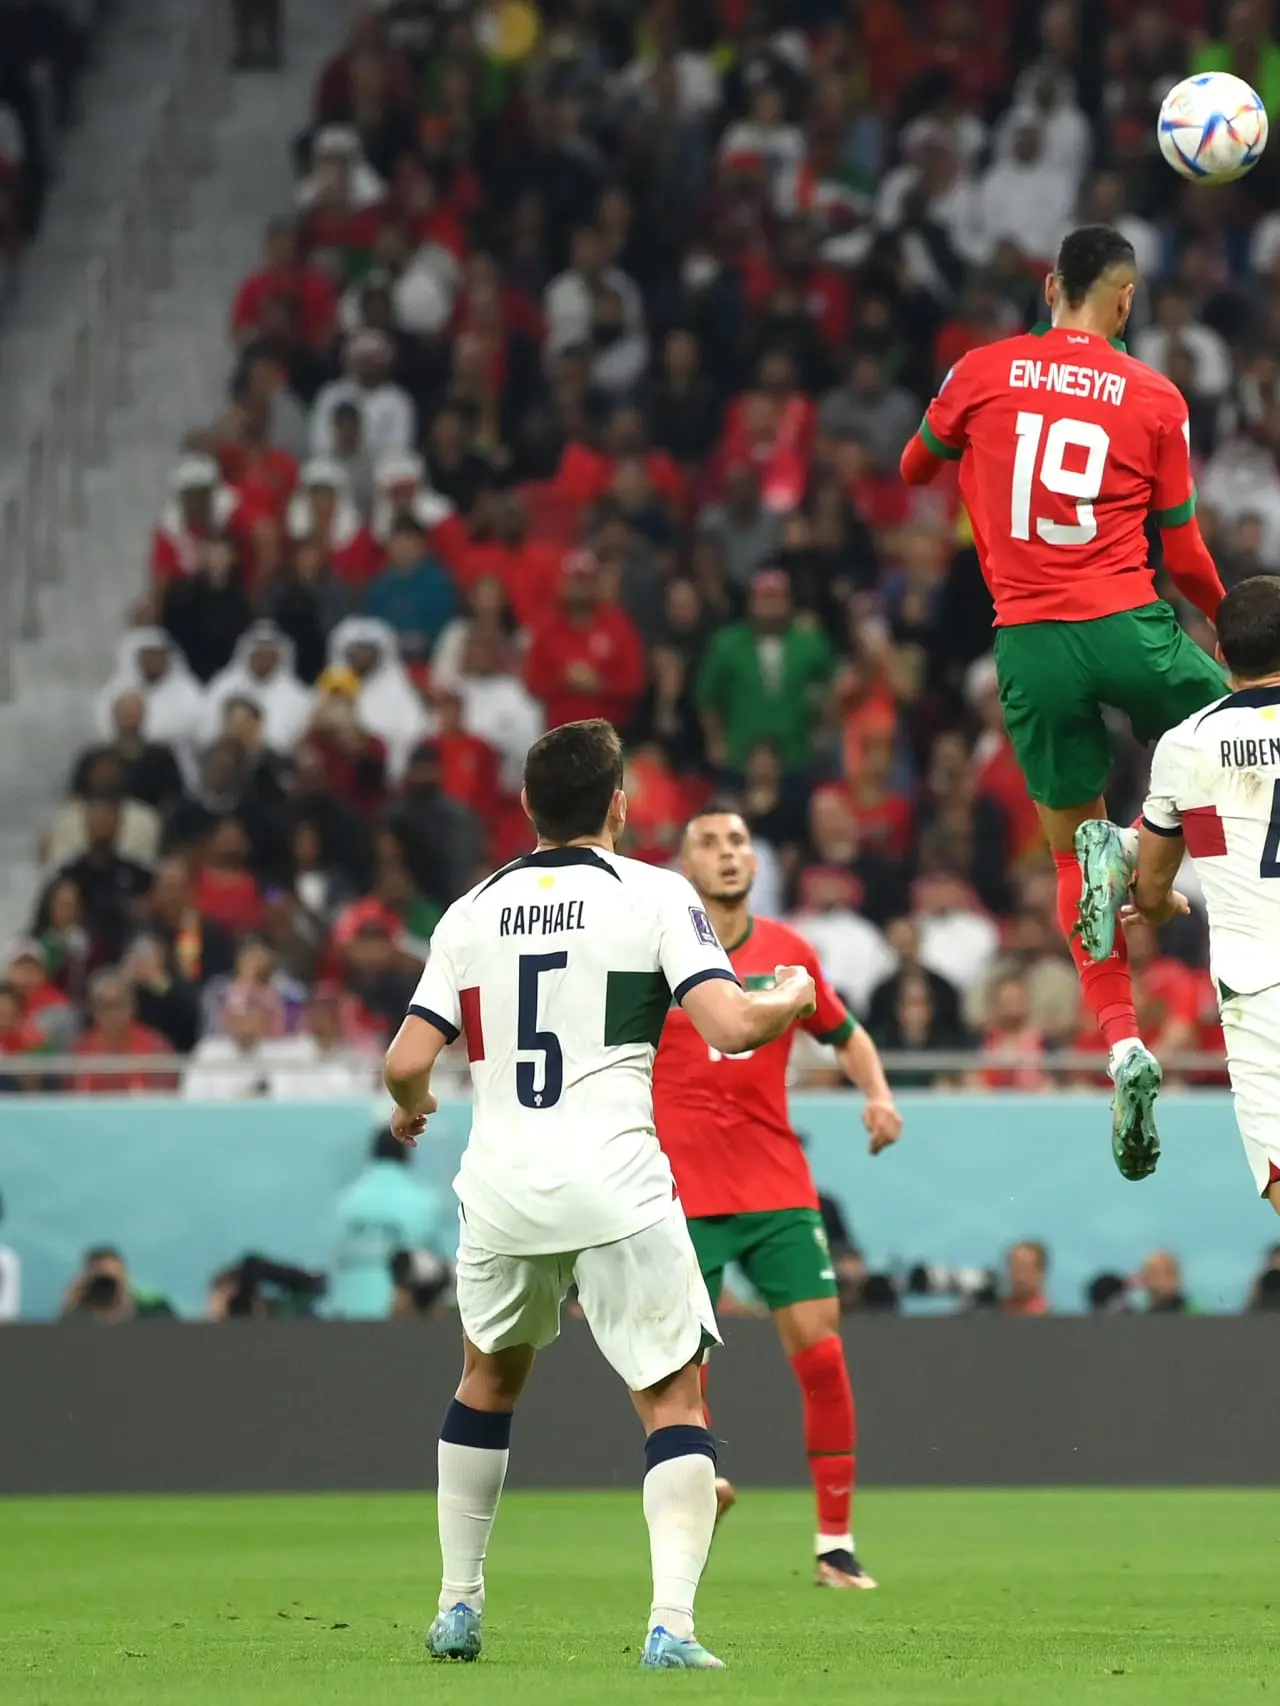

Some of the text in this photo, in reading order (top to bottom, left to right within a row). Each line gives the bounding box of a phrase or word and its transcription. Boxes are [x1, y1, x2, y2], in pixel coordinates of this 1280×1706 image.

[1009, 360, 1126, 406] EN-NESYRI
[1011, 411, 1110, 546] 19
[500, 900, 585, 937] RAPHAEL
[516, 950, 568, 1109] 5
